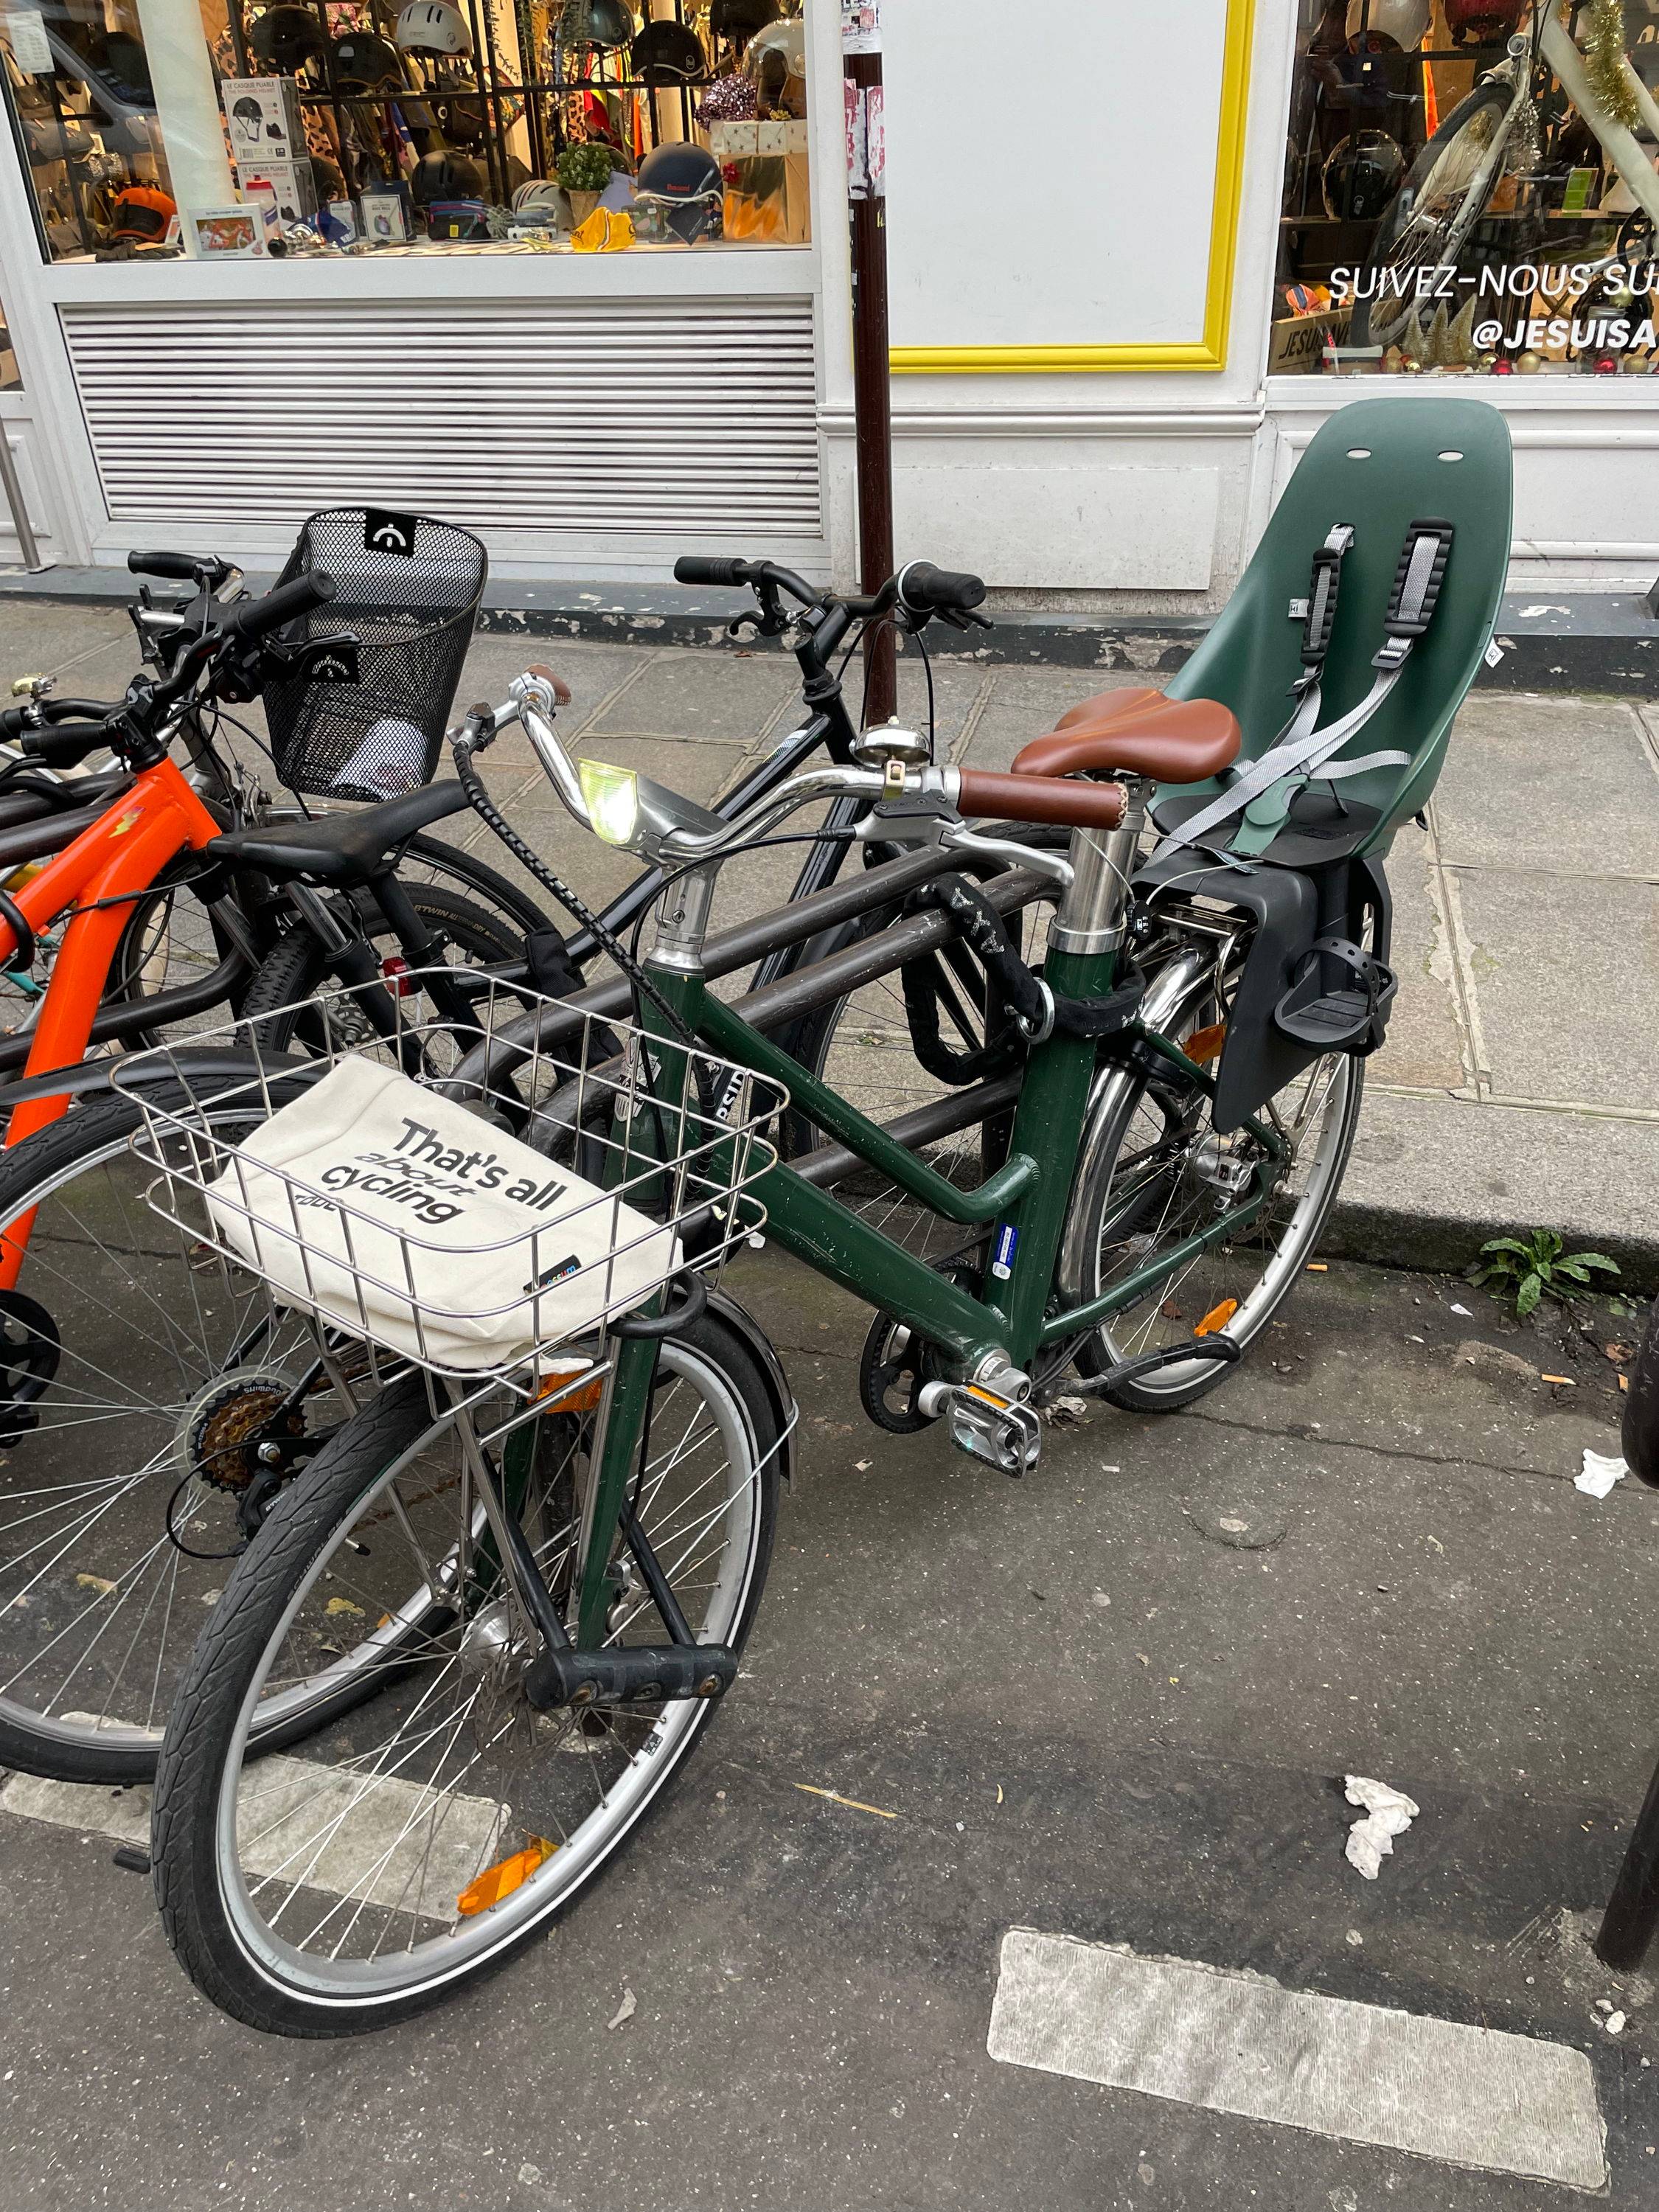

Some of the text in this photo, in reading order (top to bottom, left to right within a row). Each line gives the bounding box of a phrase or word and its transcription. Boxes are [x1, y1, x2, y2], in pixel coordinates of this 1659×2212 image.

[1329, 263, 1659, 299] SUIVEZ-NOUS SU
[1472, 319, 1657, 349] @JESUISA
[353, 1152, 479, 1197] about
[392, 1116, 568, 1211] That's all
[320, 1165, 467, 1225] cycling
[243, 1385, 282, 1397] SHIMANO
